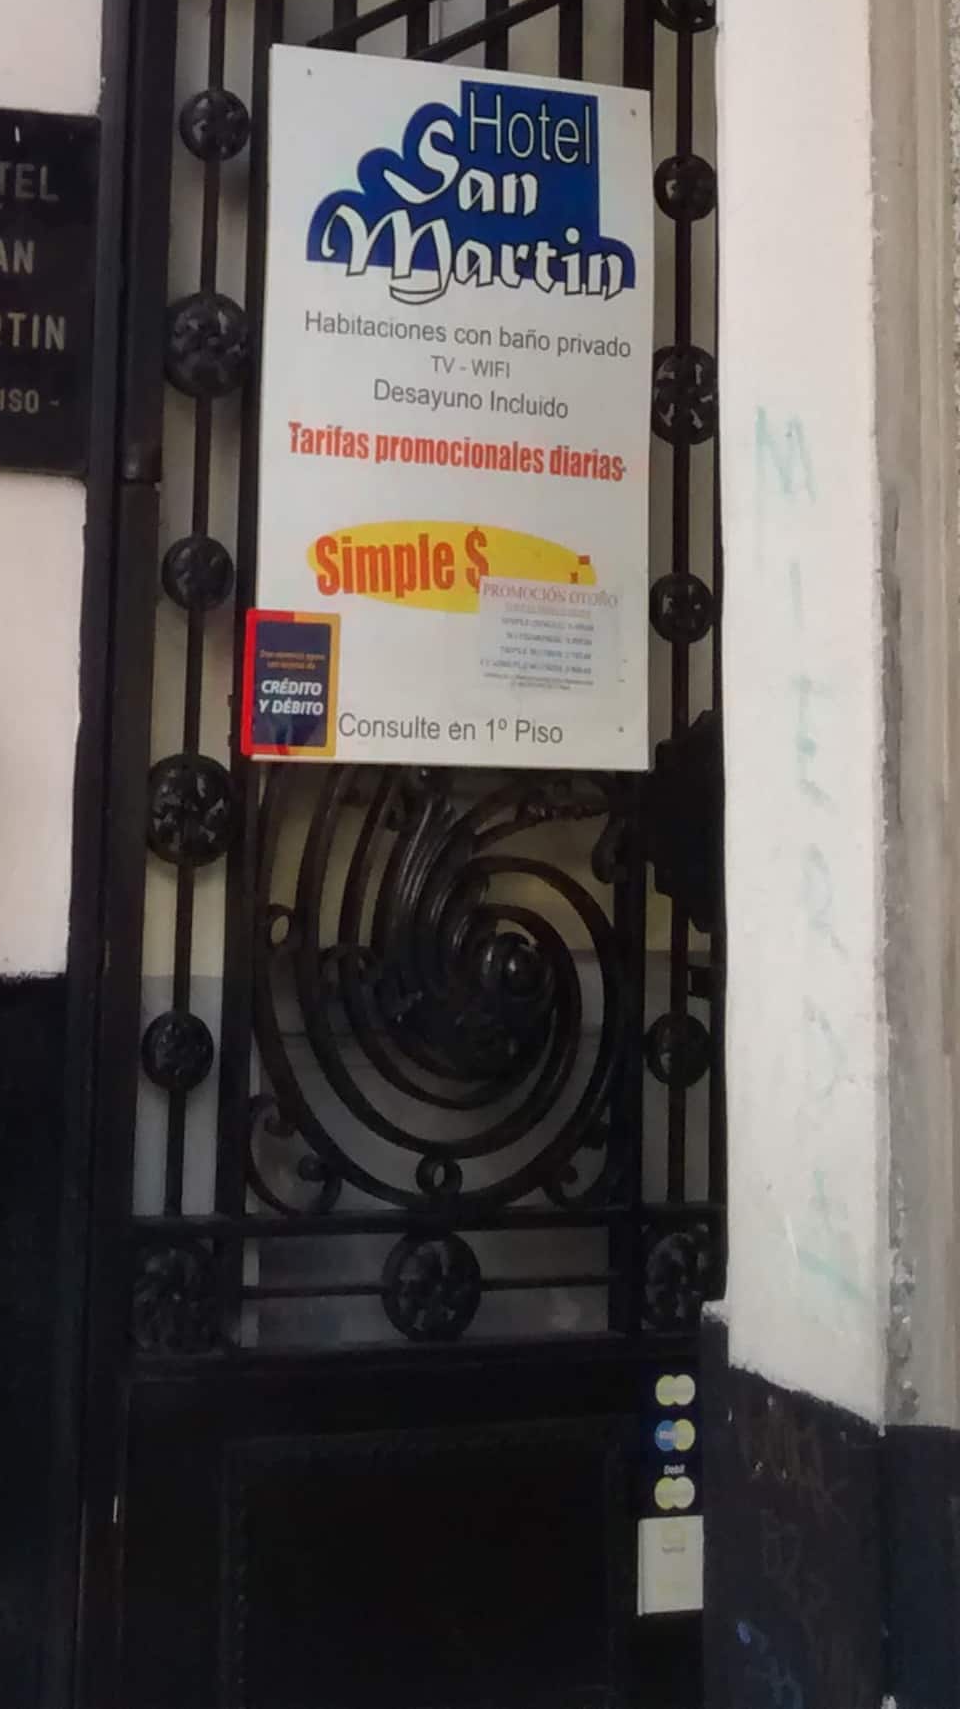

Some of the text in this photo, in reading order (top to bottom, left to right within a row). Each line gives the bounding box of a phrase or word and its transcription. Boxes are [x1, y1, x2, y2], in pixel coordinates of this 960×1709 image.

[468, 90, 592, 165] Hotel
[383, 118, 539, 217] San
[320, 204, 624, 305] Martin
[304, 310, 632, 358] Habitaciones con baño privado
[430, 355, 456, 374] TV
[471, 359, 511, 379] WIFI
[373, 379, 569, 419] Desayuno Incluido
[288, 421, 624, 483] Tarifas promocionales diarias
[314, 533, 456, 599] Simple
[259, 697, 324, 716] Y DÉBITO
[261, 677, 323, 696] CRÉDITO
[338, 712, 441, 740] Consulte
[448, 720, 476, 742] en
[514, 720, 563, 744] Piso
